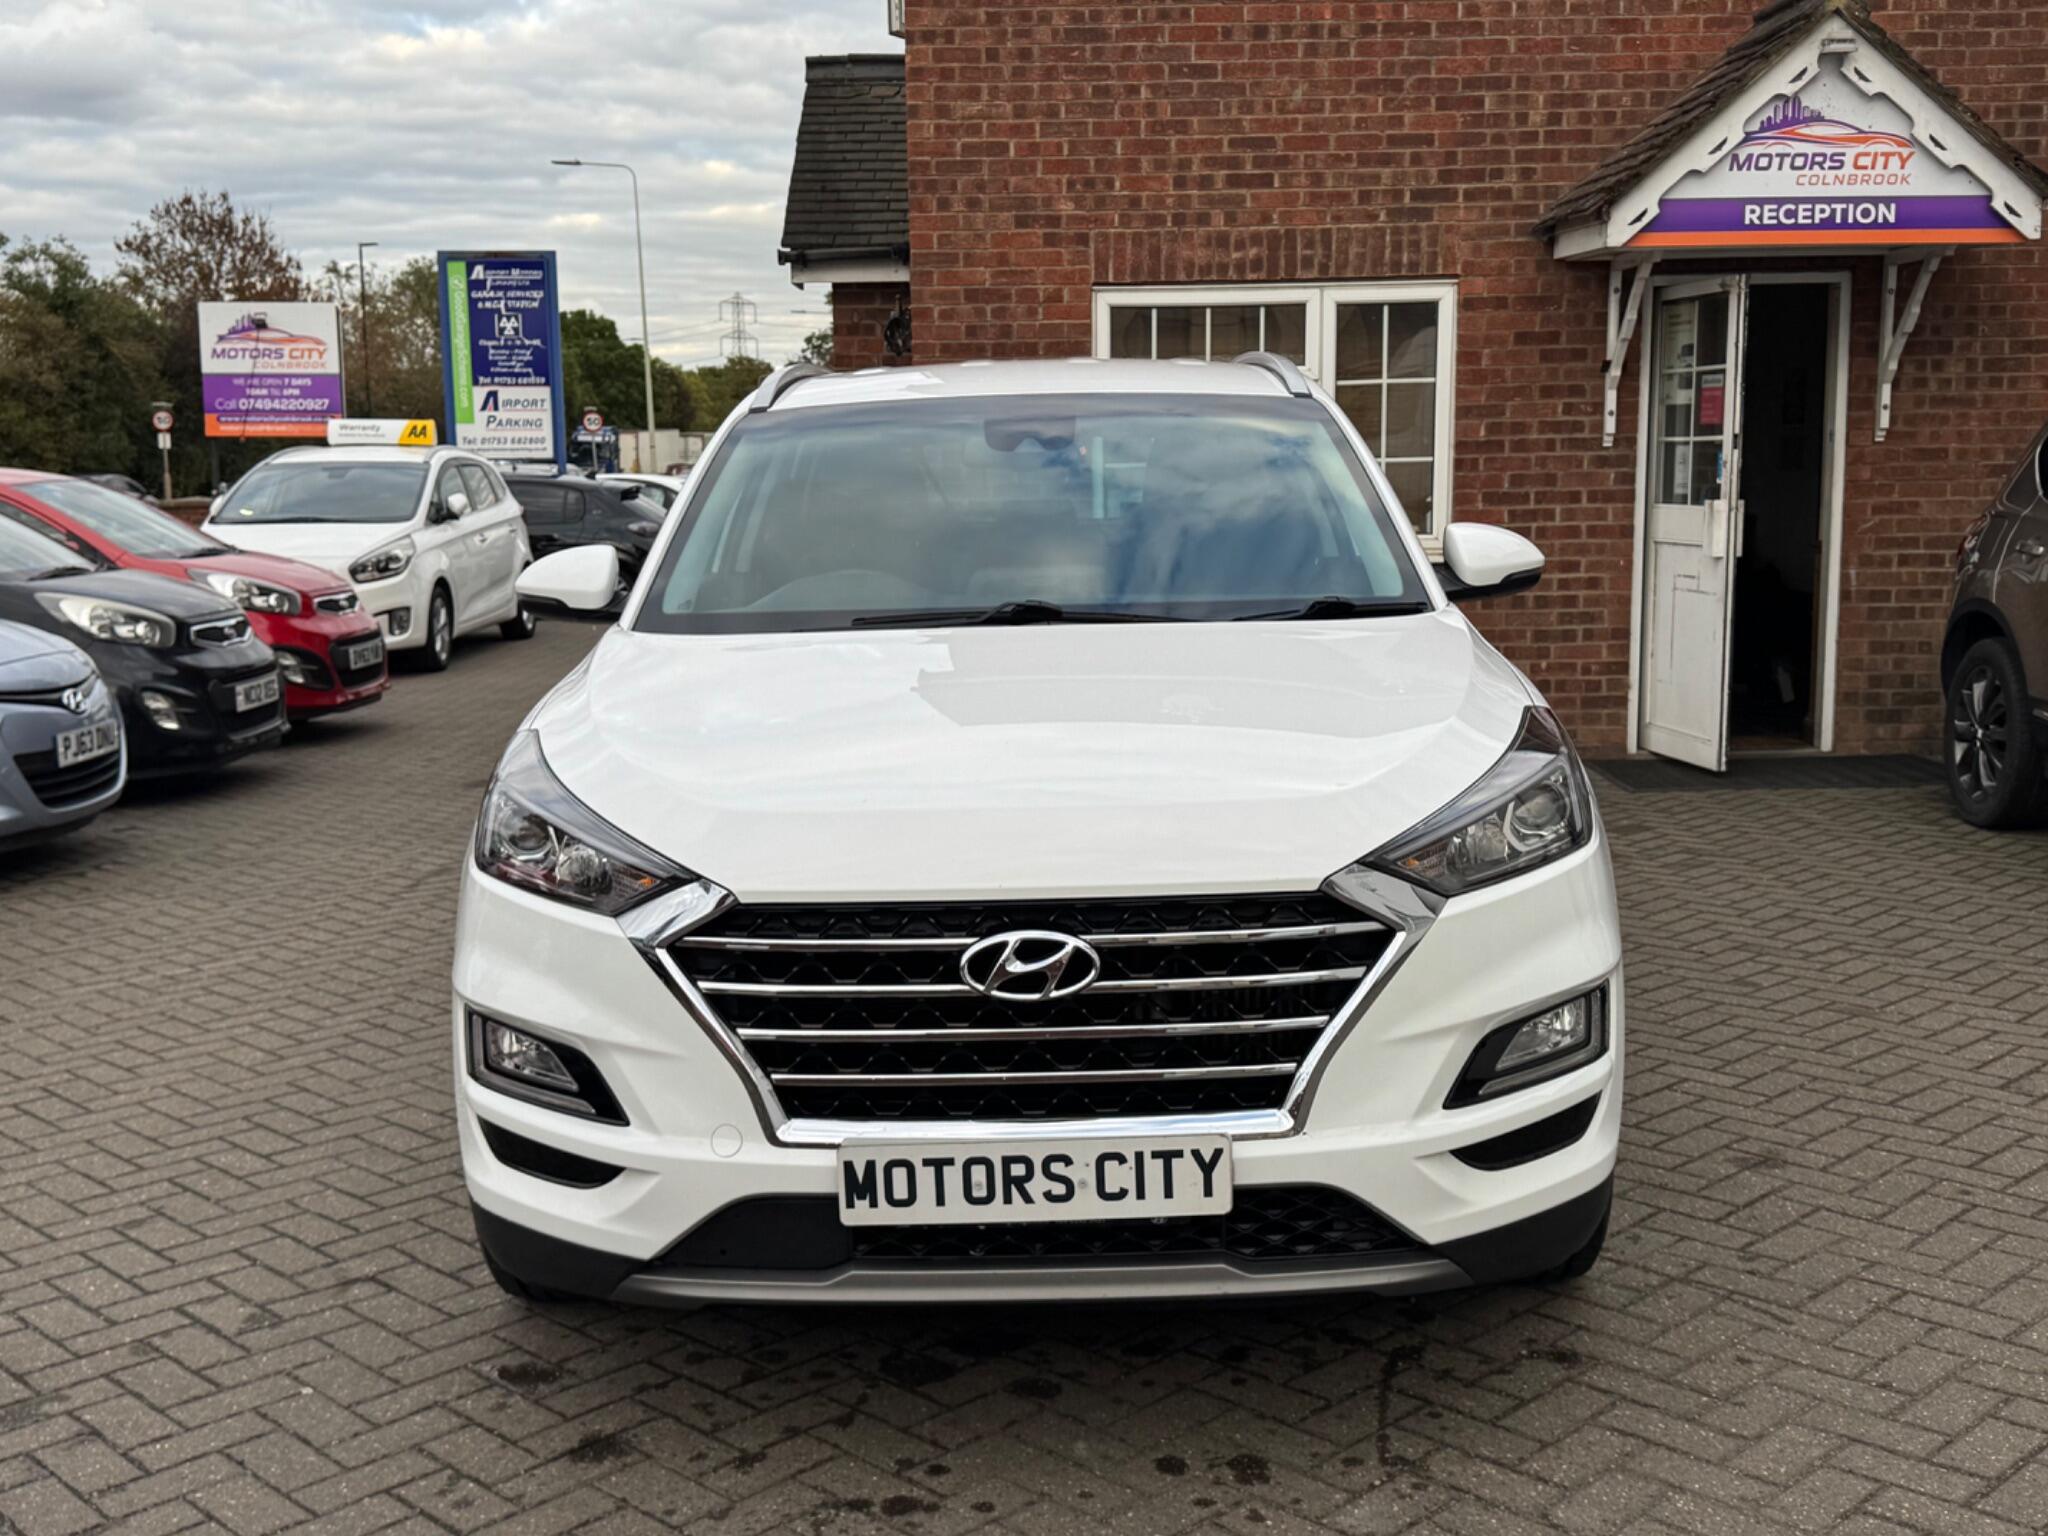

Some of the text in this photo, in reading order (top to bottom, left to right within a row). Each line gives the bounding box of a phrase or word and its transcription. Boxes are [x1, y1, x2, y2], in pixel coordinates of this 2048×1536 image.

[1728, 150, 1916, 172] MOTORS CITY
[1795, 173, 1912, 186] COLNBROOK
[1744, 202, 1897, 225] RECEPTION
[211, 347, 327, 360] MOTORS CITY
[254, 361, 327, 370] COLNBROOK
[291, 378, 312, 386] DAYS
[214, 398, 330, 411] Call 07494220927
[480, 389, 547, 412] AIRPORT
[486, 415, 544, 428] PARKING
[407, 424, 427, 439] AA
[462, 436, 478, 446] Tel:
[481, 436, 508, 446] 01753
[63, 728, 94, 760] PJ63
[842, 1147, 1225, 1210] MOTORS CITY
